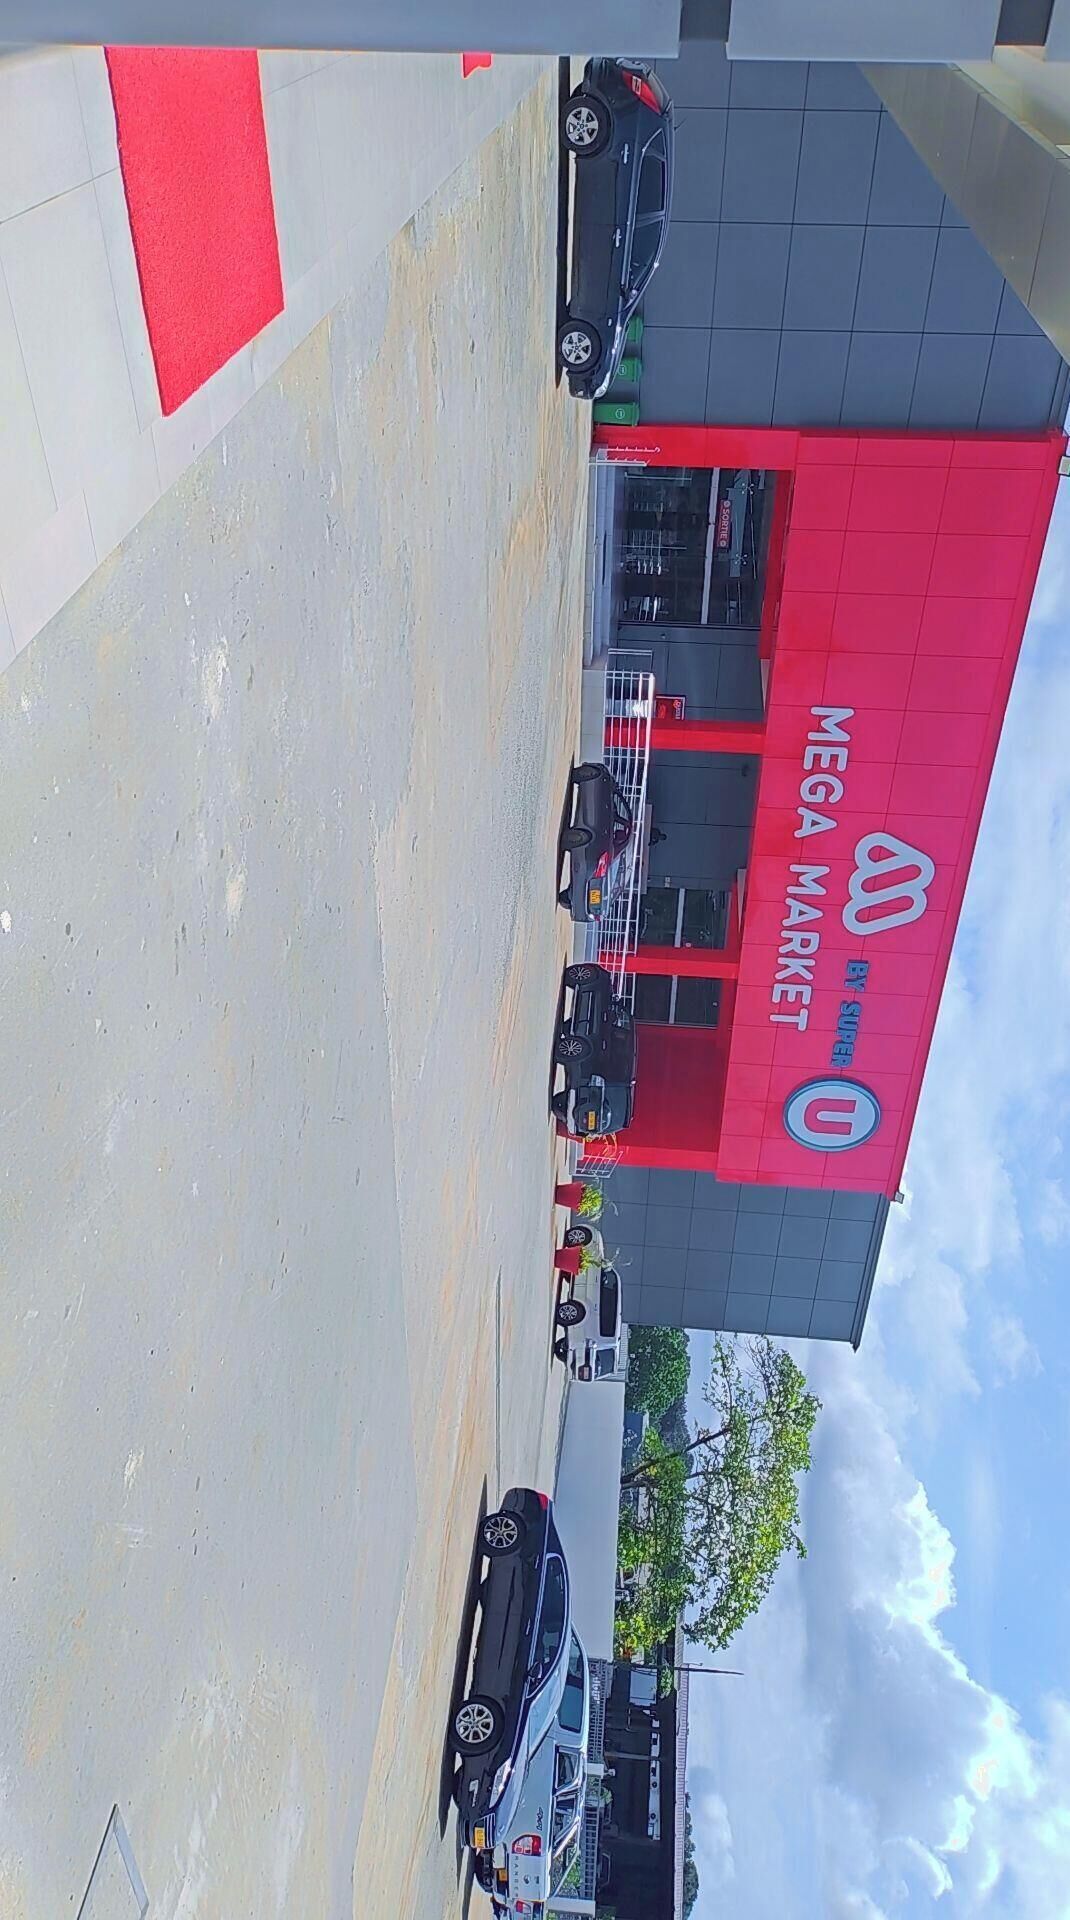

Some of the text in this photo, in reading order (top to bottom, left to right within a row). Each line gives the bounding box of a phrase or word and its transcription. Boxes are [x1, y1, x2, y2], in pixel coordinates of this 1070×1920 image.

[720, 508, 730, 540] SORTIE
[769, 705, 855, 1032] MEGA MARKET
[801, 960, 870, 1136] BY SUPER U
